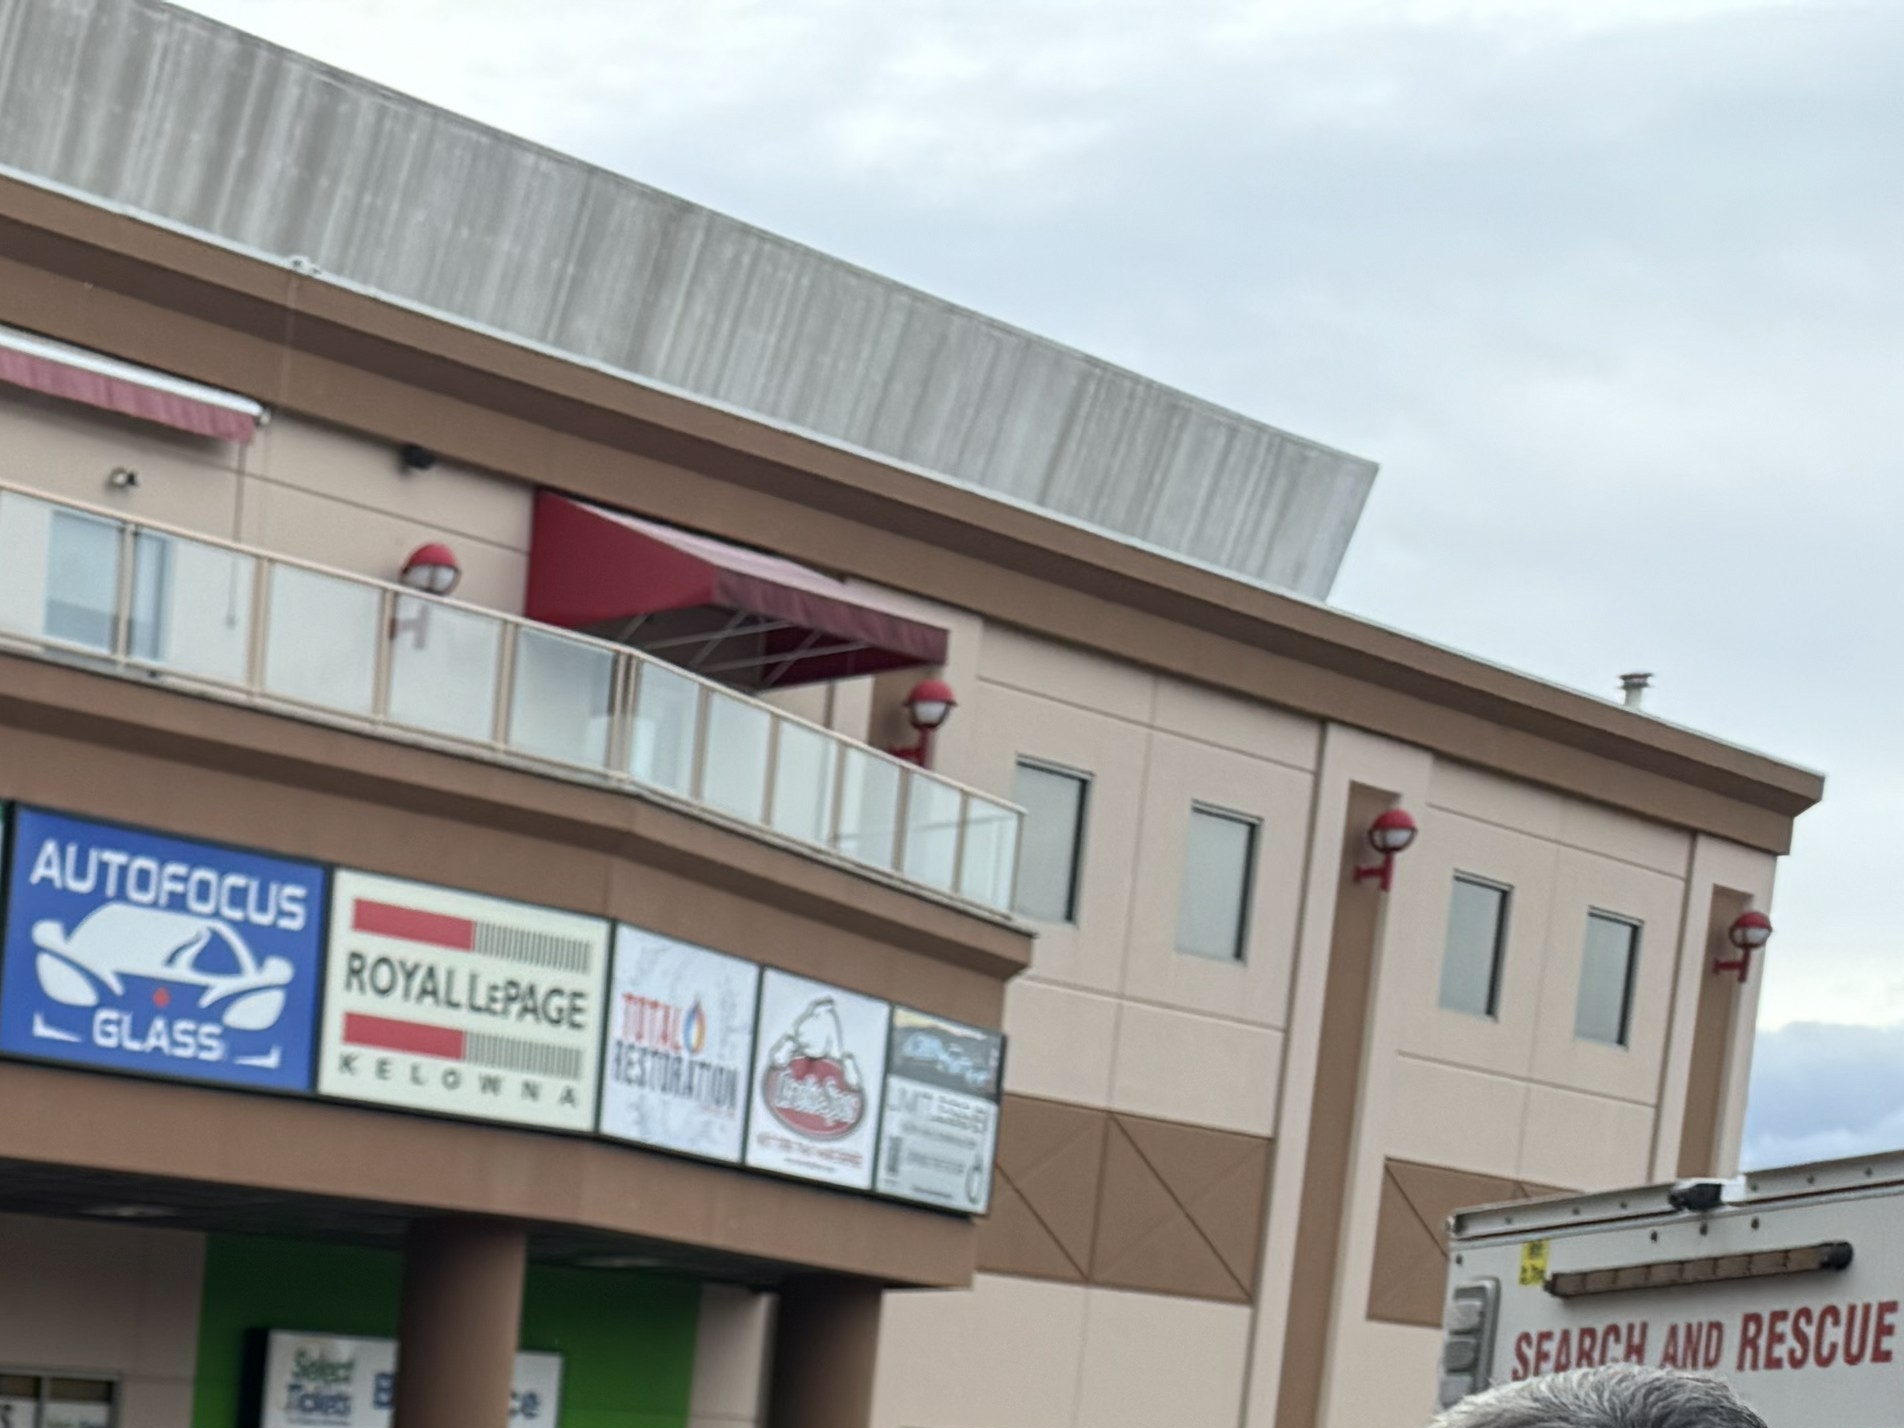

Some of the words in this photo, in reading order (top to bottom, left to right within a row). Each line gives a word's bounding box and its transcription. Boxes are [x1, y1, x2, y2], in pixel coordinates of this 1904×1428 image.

[30, 839, 308, 931] AUTOFOCUS
[92, 1008, 224, 1061] GLASS
[622, 993, 682, 1054] TOTAL
[1660, 1320, 1725, 1370] AND
[1736, 1301, 1898, 1372] RESCUE
